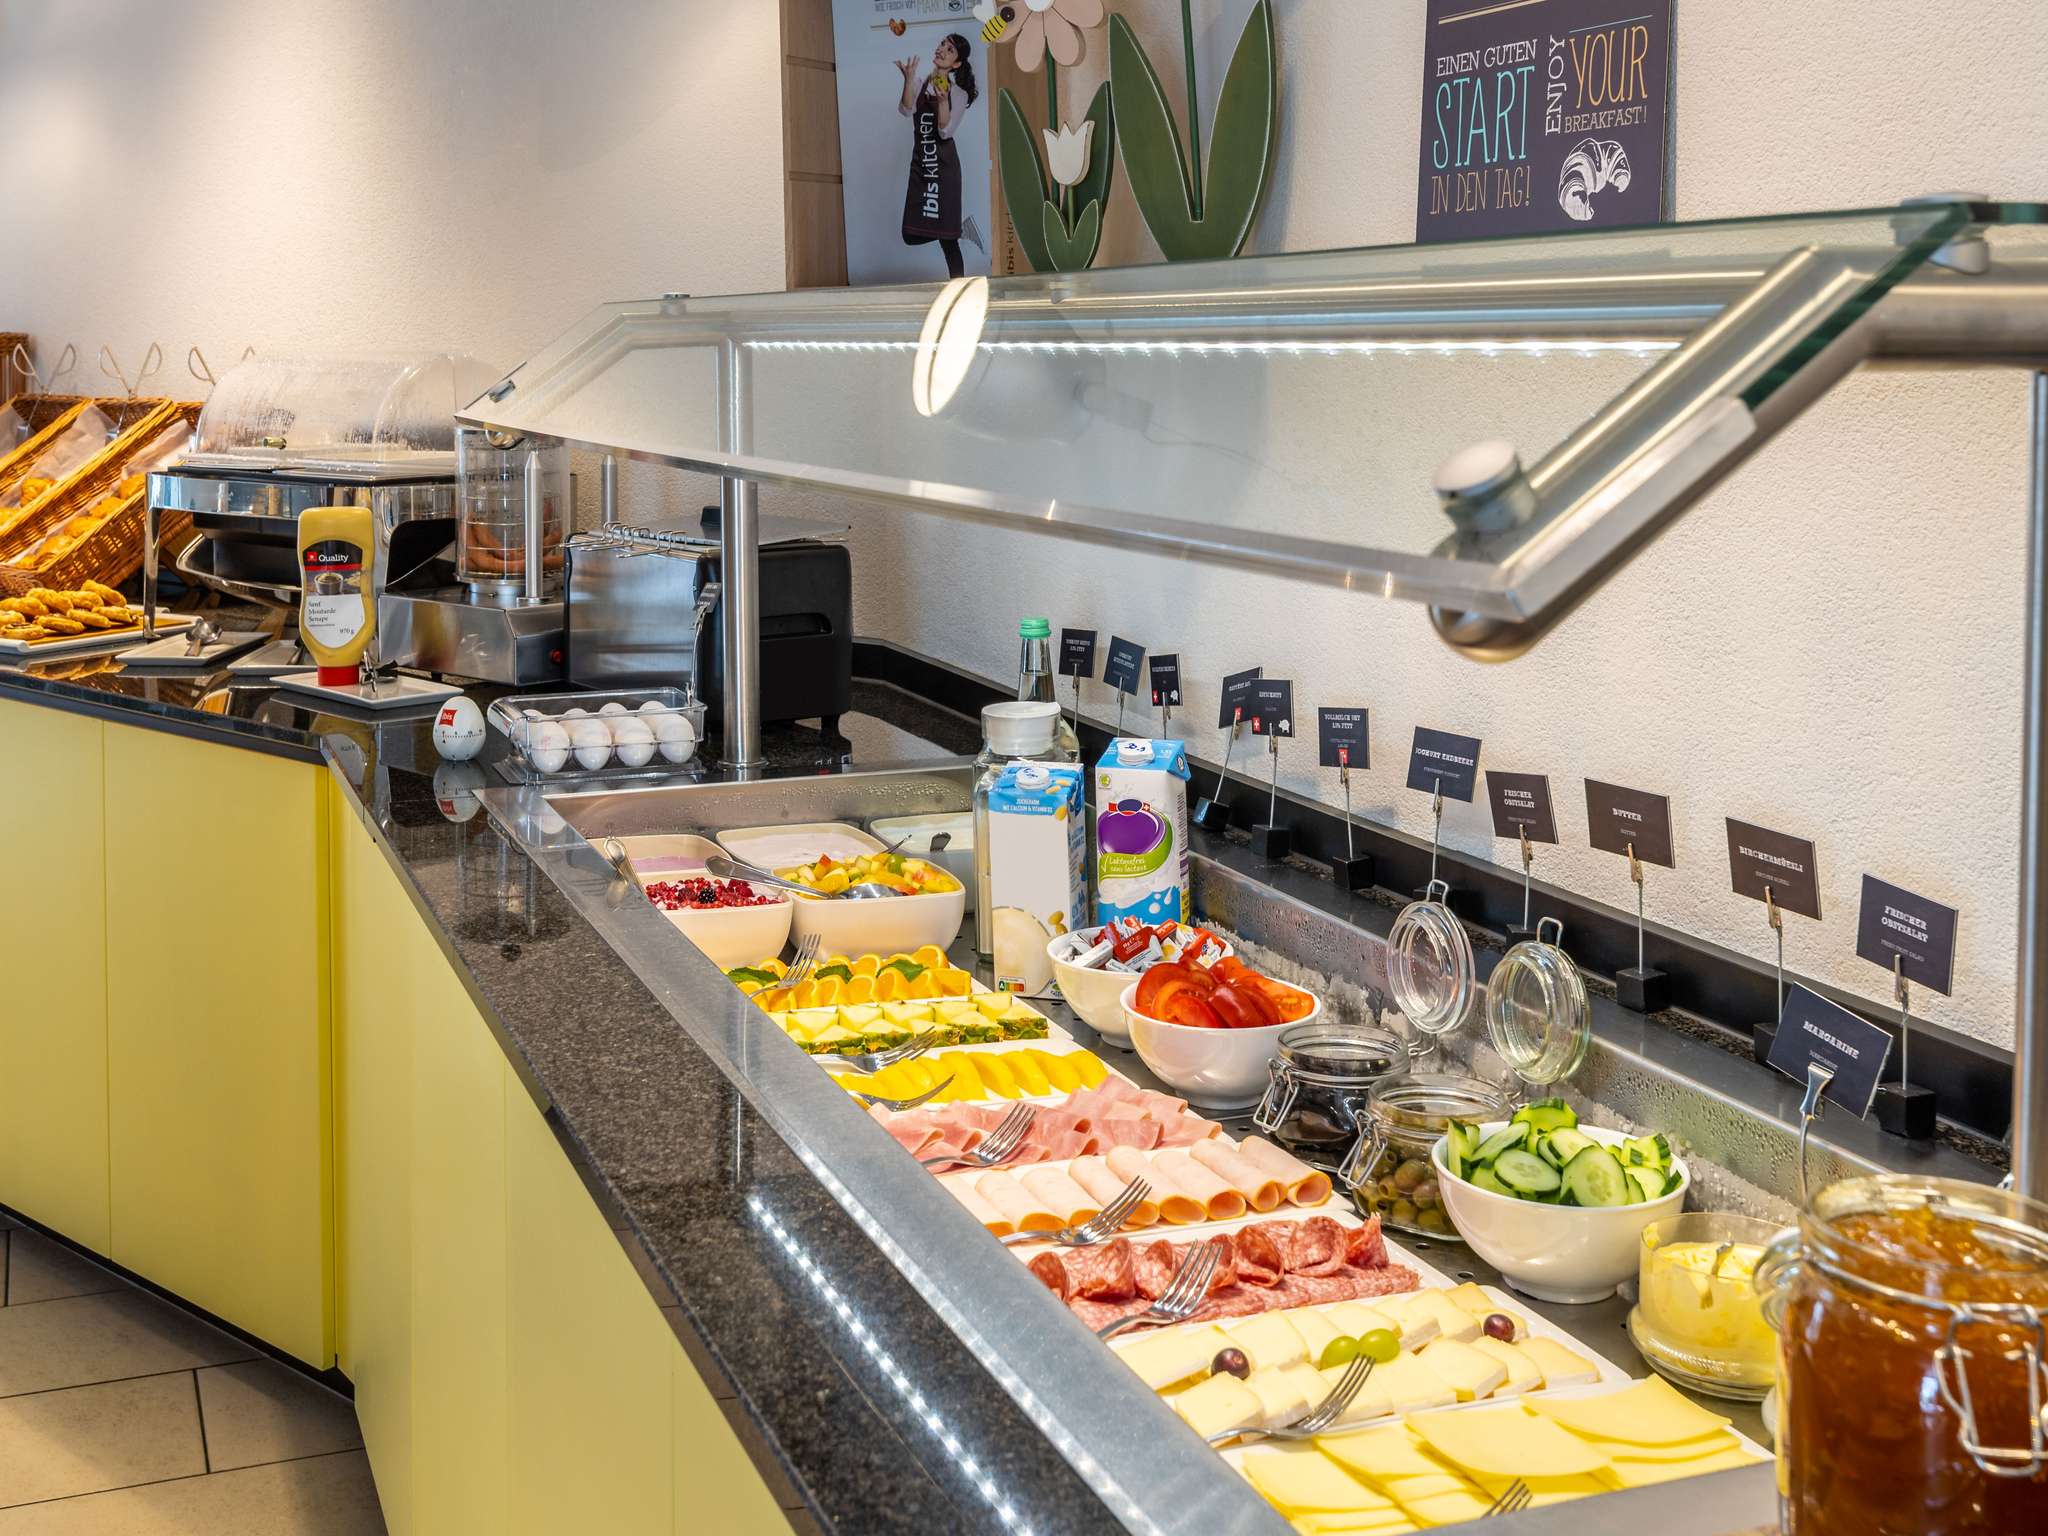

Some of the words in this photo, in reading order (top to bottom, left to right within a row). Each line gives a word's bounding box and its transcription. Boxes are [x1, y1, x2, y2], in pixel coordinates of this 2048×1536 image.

[1436, 50, 1480, 77] EINEN
[1484, 39, 1538, 68] GUTEN
[1569, 24, 1649, 109] YOUR
[1545, 35, 1567, 136] ENJOY
[1433, 65, 1536, 170] START
[1564, 105, 1648, 134] BREAKFAST!
[919, 112, 939, 178] kitchen
[923, 182, 939, 219] ibis
[1430, 174, 1450, 215] IN
[1455, 170, 1489, 213] DEN
[1495, 166, 1531, 209] TAG!
[318, 553, 349, 563] Quality
[442, 711, 453, 720] ibis
[1503, 789, 1533, 799] FRISCHER
[1612, 807, 1642, 822] BUTTER
[1881, 916, 1929, 943] OBSTSALAT
[1884, 905, 1928, 931] FRISCHER
[1802, 1020, 1860, 1060] MARGARINE
